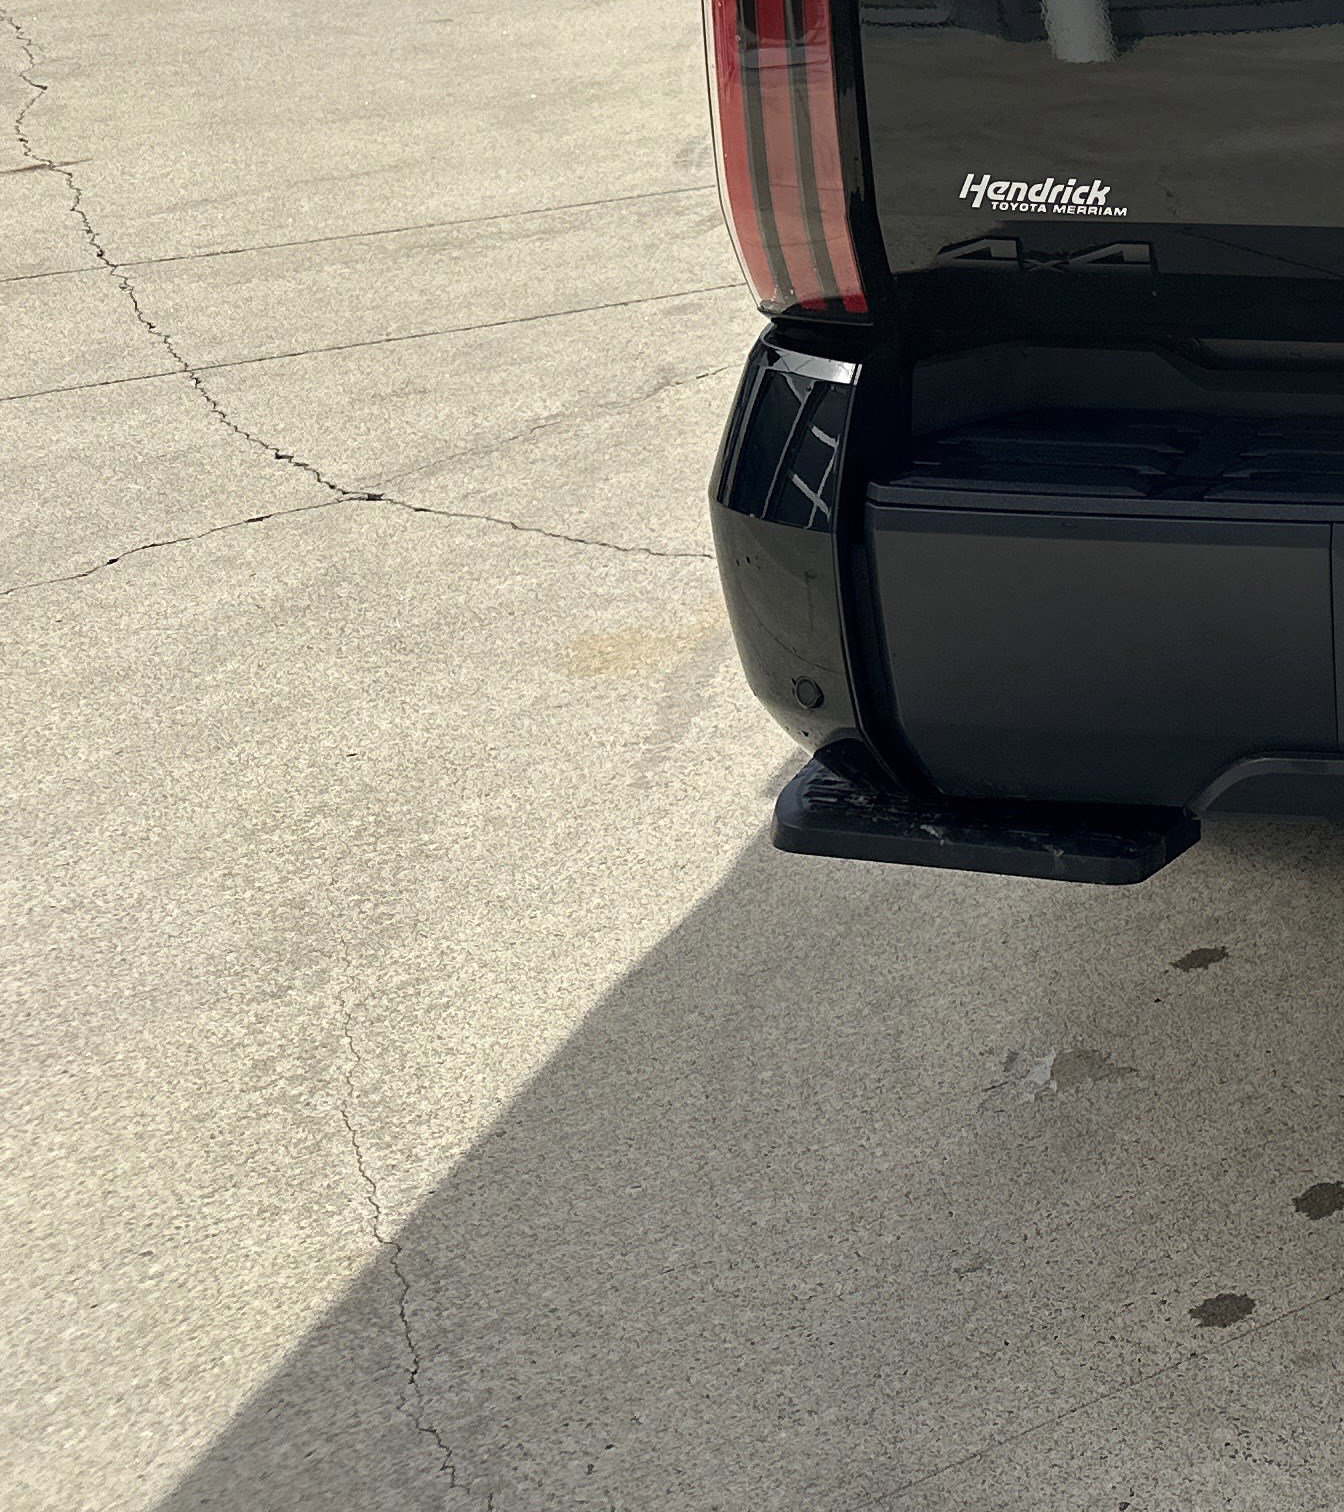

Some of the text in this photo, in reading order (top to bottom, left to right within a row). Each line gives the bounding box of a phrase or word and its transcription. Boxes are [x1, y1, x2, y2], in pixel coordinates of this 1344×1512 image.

[958, 173, 1111, 208] Hendrick
[991, 201, 1128, 218] TOYOTA MERRIAM
